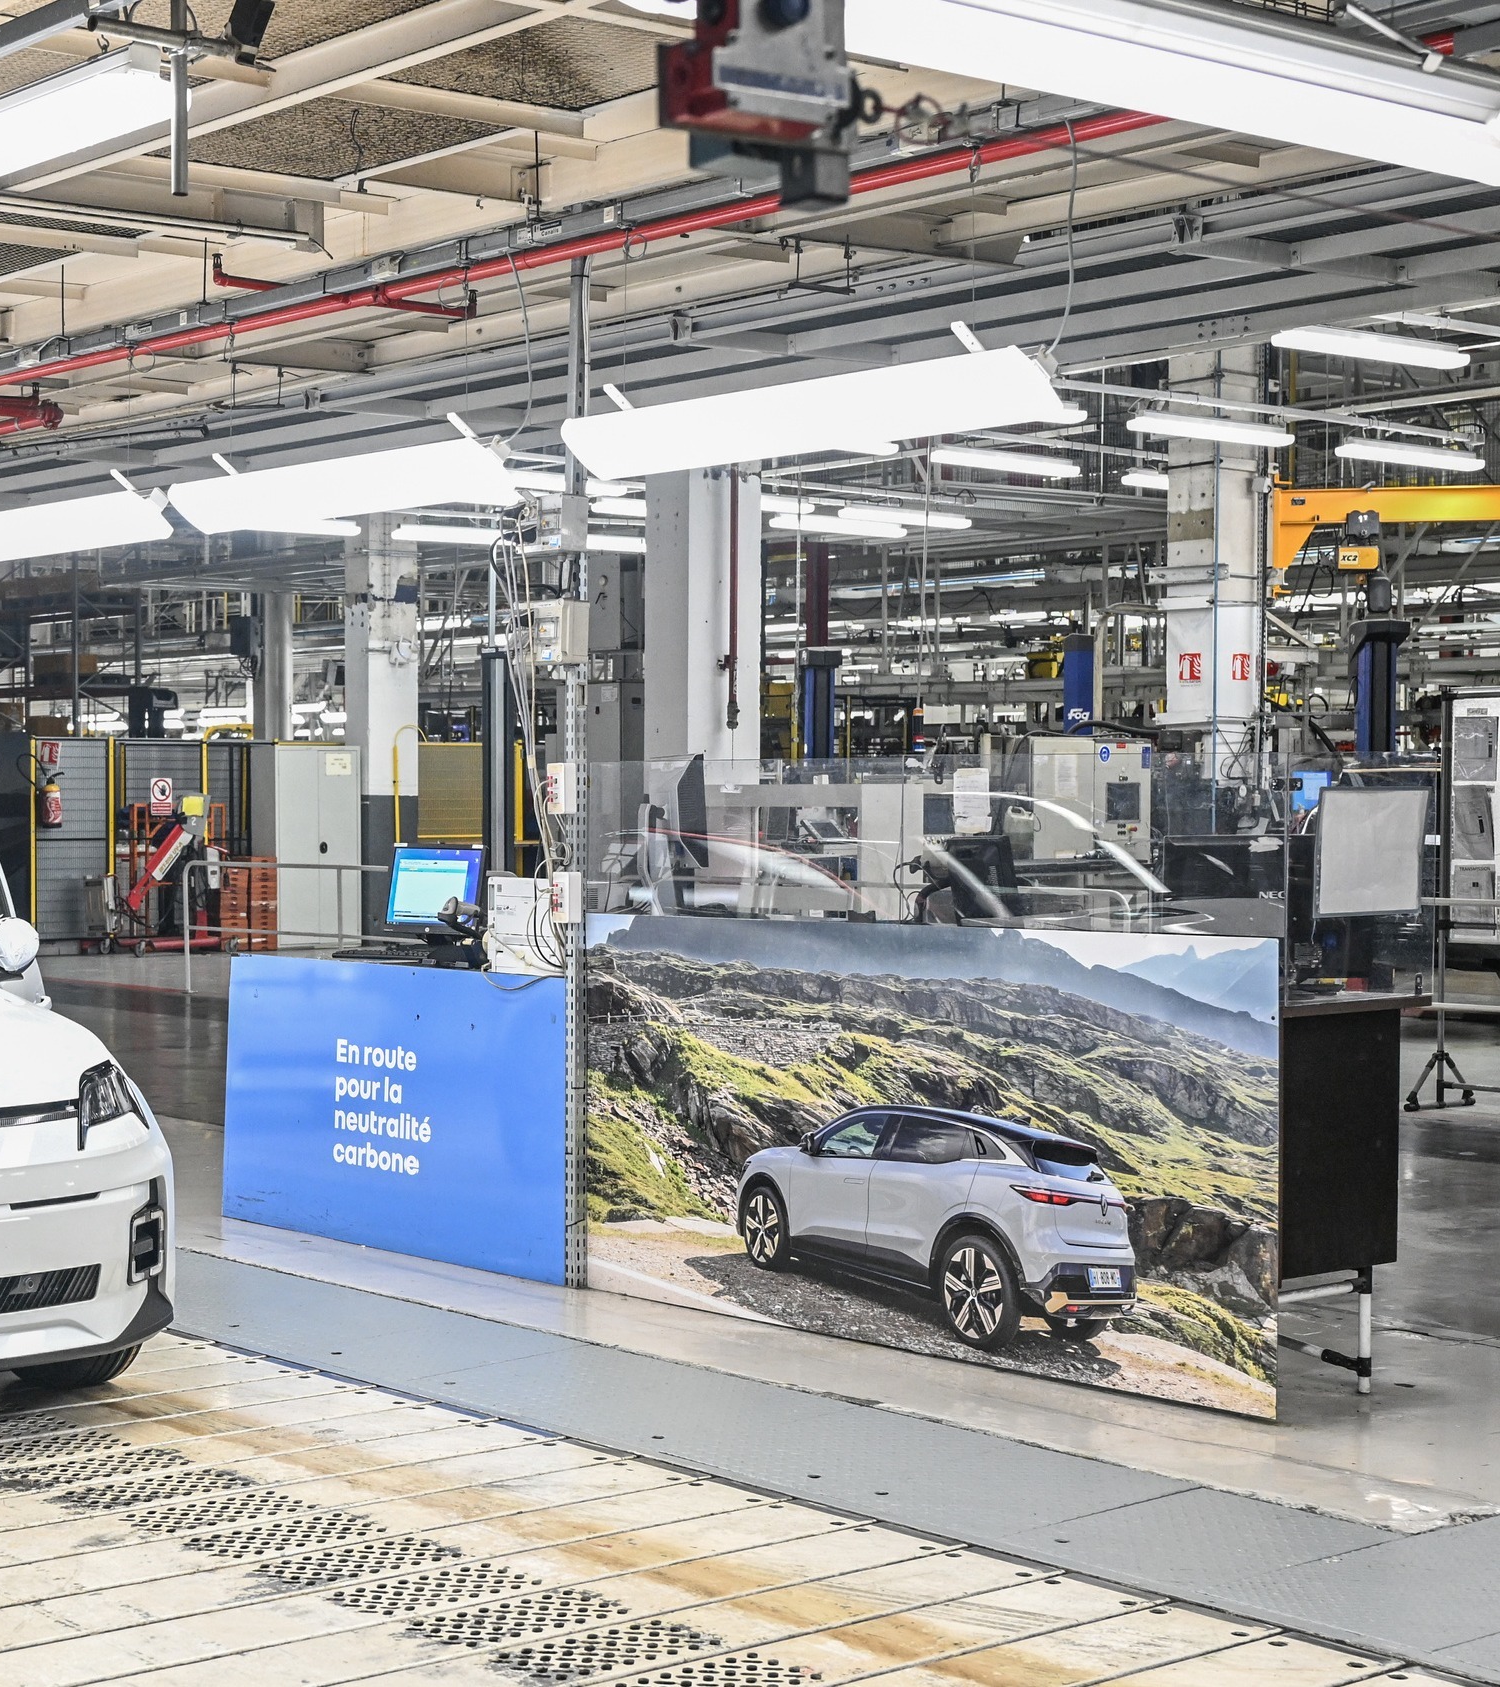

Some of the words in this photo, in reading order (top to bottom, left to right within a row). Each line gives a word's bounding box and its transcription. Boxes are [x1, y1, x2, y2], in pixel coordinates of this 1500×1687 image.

[1067, 708, 1090, 723] Fog
[336, 1038, 360, 1065] En
[363, 1045, 417, 1071] route
[334, 1076, 381, 1102] pour
[384, 1076, 403, 1104] la
[334, 1109, 432, 1143] neutralité
[332, 1141, 420, 1176] carbone
